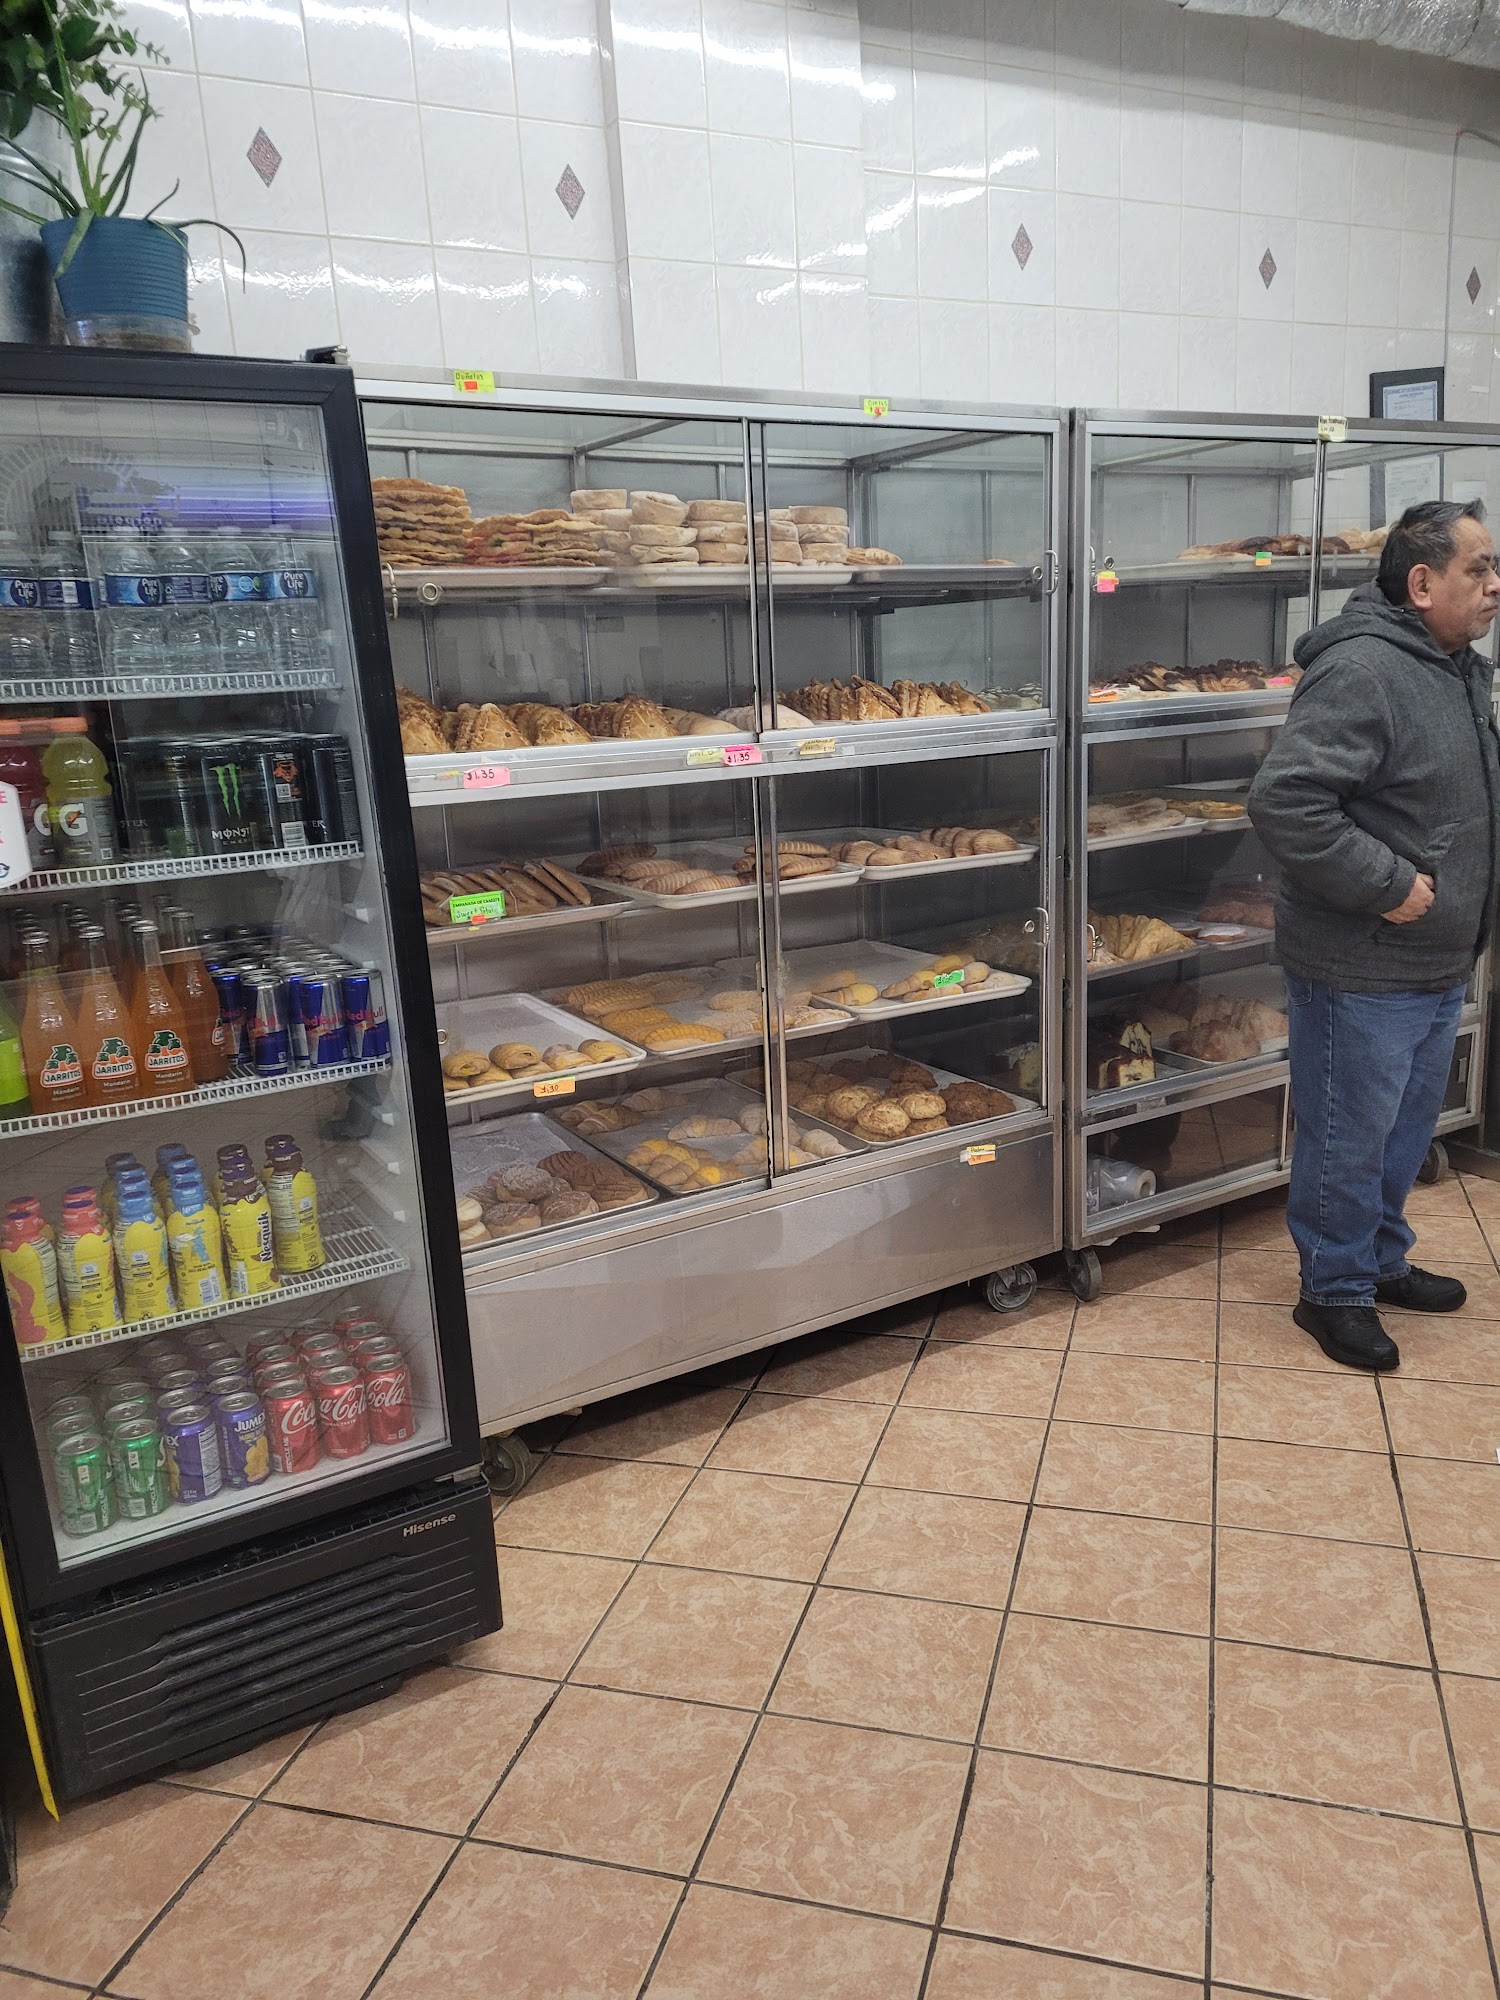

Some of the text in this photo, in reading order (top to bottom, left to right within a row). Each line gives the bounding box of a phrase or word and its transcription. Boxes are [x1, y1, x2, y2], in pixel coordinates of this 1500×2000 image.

[284, 571, 305, 580] Pure
[15, 580, 34, 589] Pure
[287, 580, 303, 590] Life
[18, 589, 34, 600] Life
[727, 752, 750, 763] $1.35
[467, 769, 495, 780] $1.35
[59, 803, 88, 837] G
[211, 826, 250, 839] MONST
[149, 1055, 185, 1066] JARRITOS
[96, 1063, 132, 1074] JARRITOS
[45, 1069, 80, 1082] JARRITOS
[258, 1212, 272, 1262] Nesquik
[367, 1372, 406, 1407] Cola
[285, 1447, 293, 1473] RECYCLE
[149, 1487, 158, 1514] RECYCLE
[403, 1513, 457, 1537] Hisense
